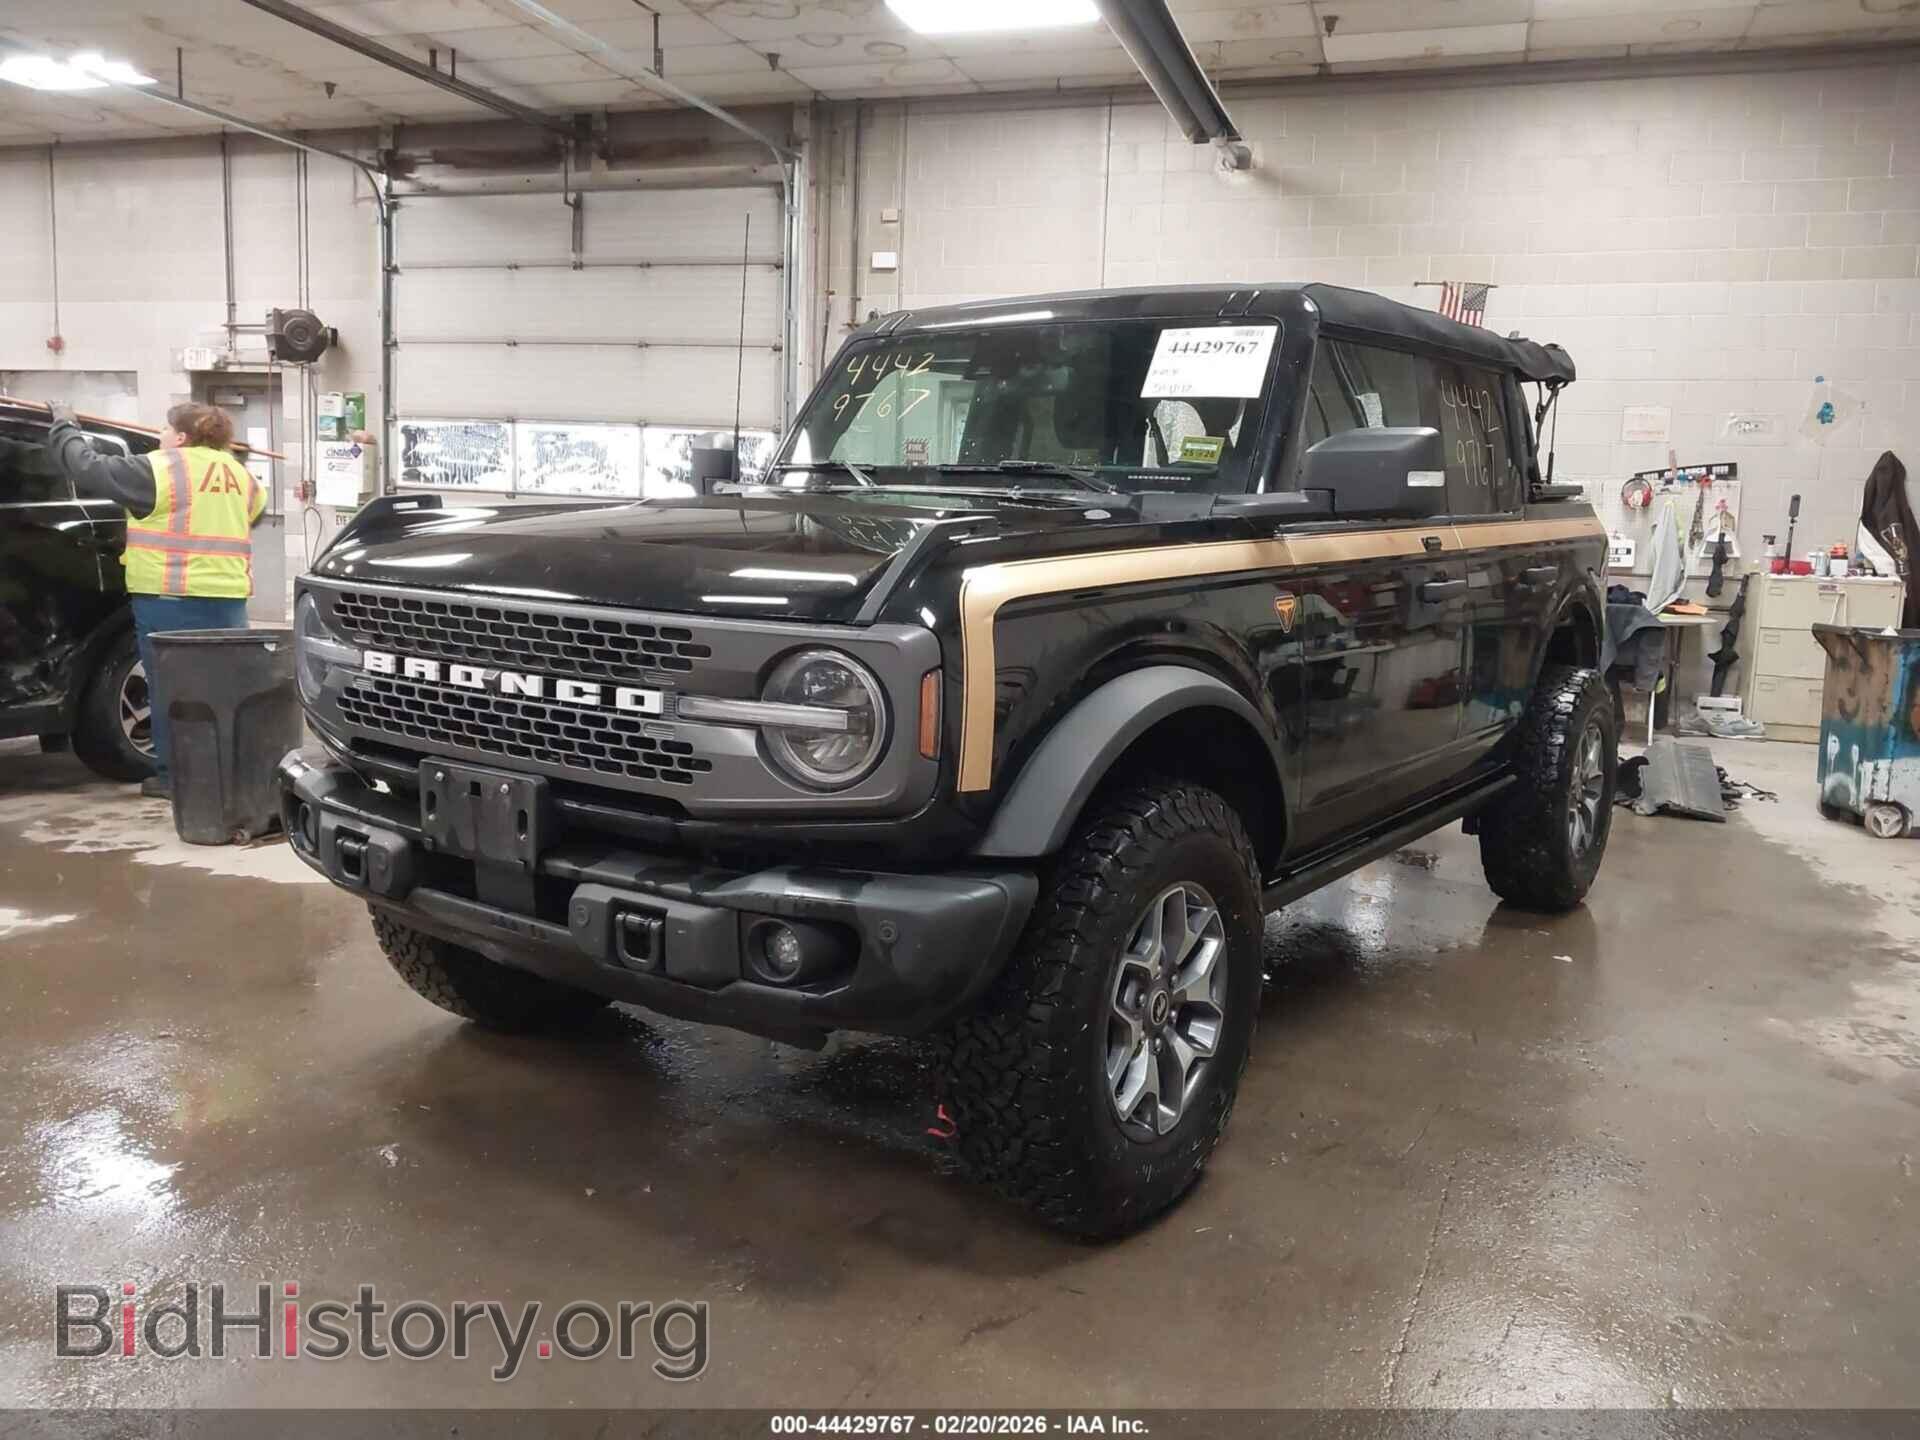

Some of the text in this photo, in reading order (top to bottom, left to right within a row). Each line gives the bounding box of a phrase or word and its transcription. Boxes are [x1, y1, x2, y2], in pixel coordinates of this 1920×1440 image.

[1168, 340, 1258, 355] 44429767
[847, 352, 935, 386] 4442
[833, 388, 932, 421] 9767
[1440, 375, 1500, 436] 4442
[1456, 439, 1496, 489] 9767
[363, 650, 665, 715] BRONCO
